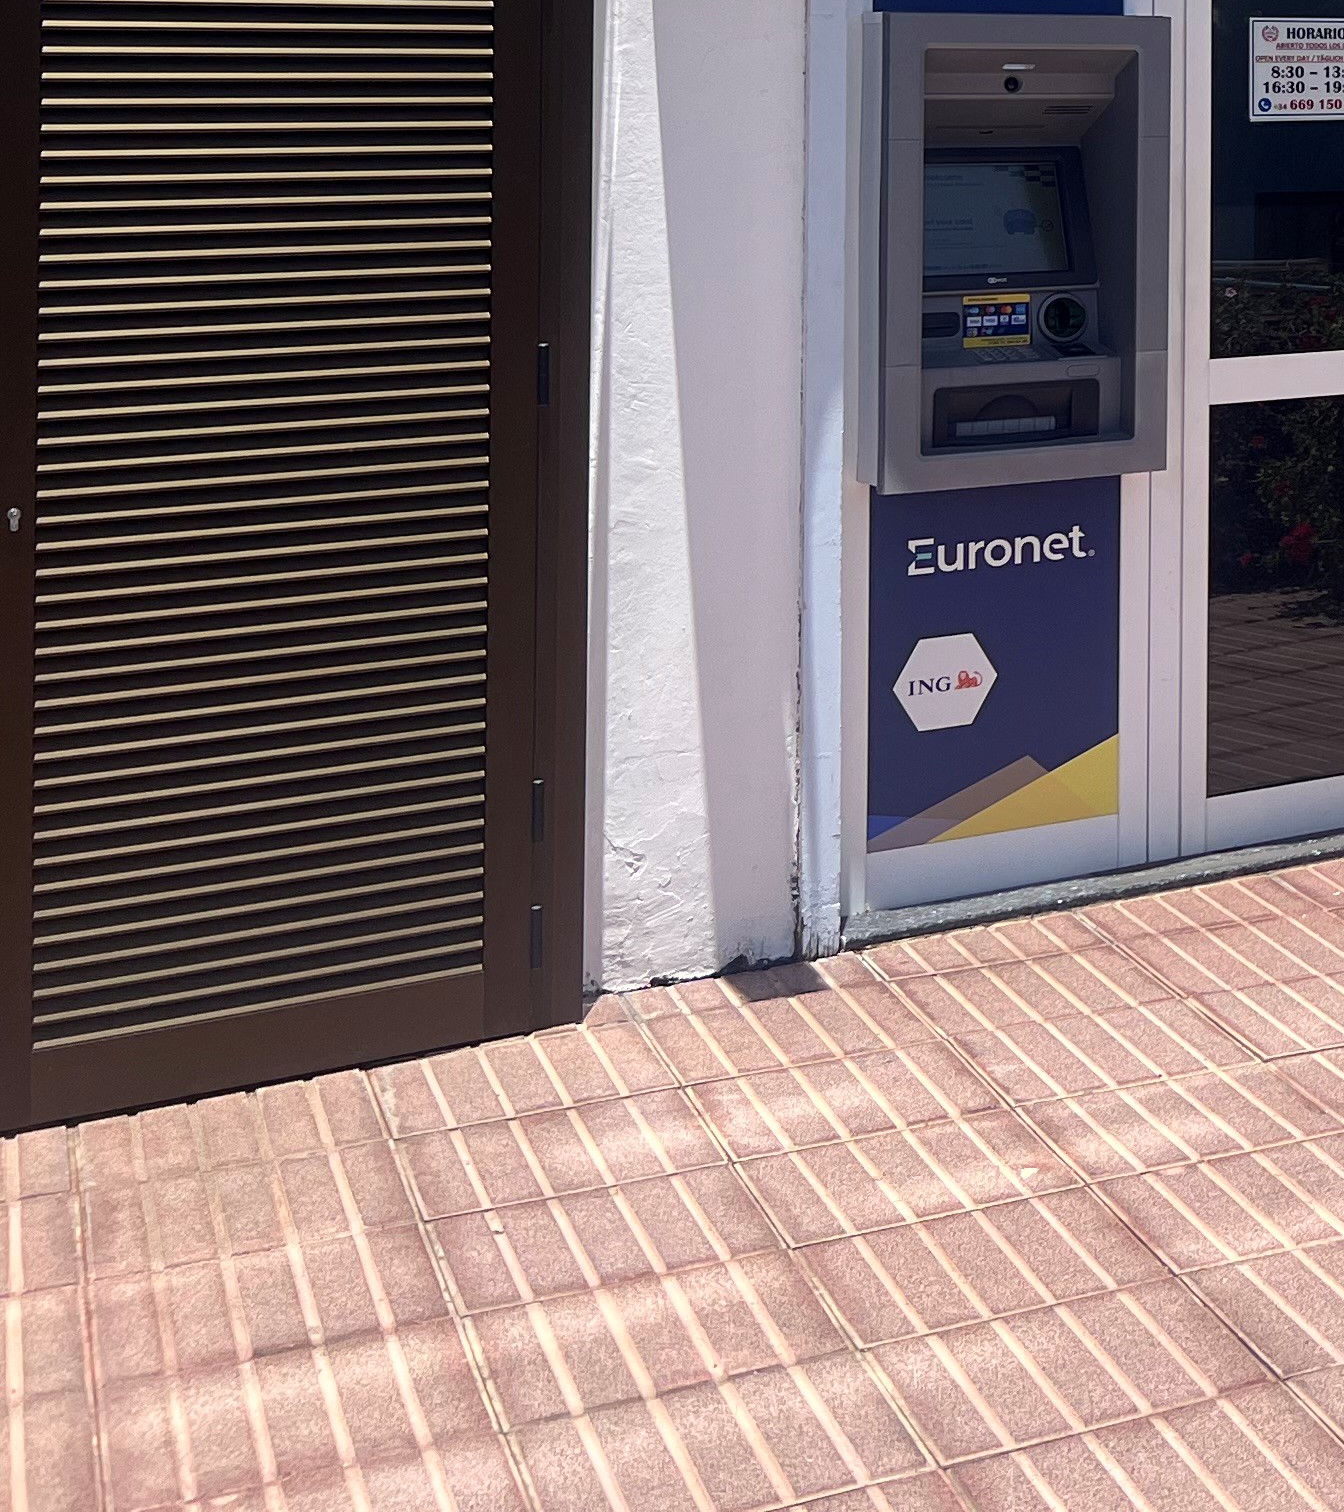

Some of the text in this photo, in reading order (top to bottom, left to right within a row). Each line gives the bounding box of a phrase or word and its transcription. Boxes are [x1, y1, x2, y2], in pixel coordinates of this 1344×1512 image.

[1271, 65, 1305, 79] 8:30
[1263, 81, 1306, 94] 16:30
[1290, 99, 1315, 110] 669
[1319, 99, 1343, 110] 150
[907, 676, 952, 697] ING
